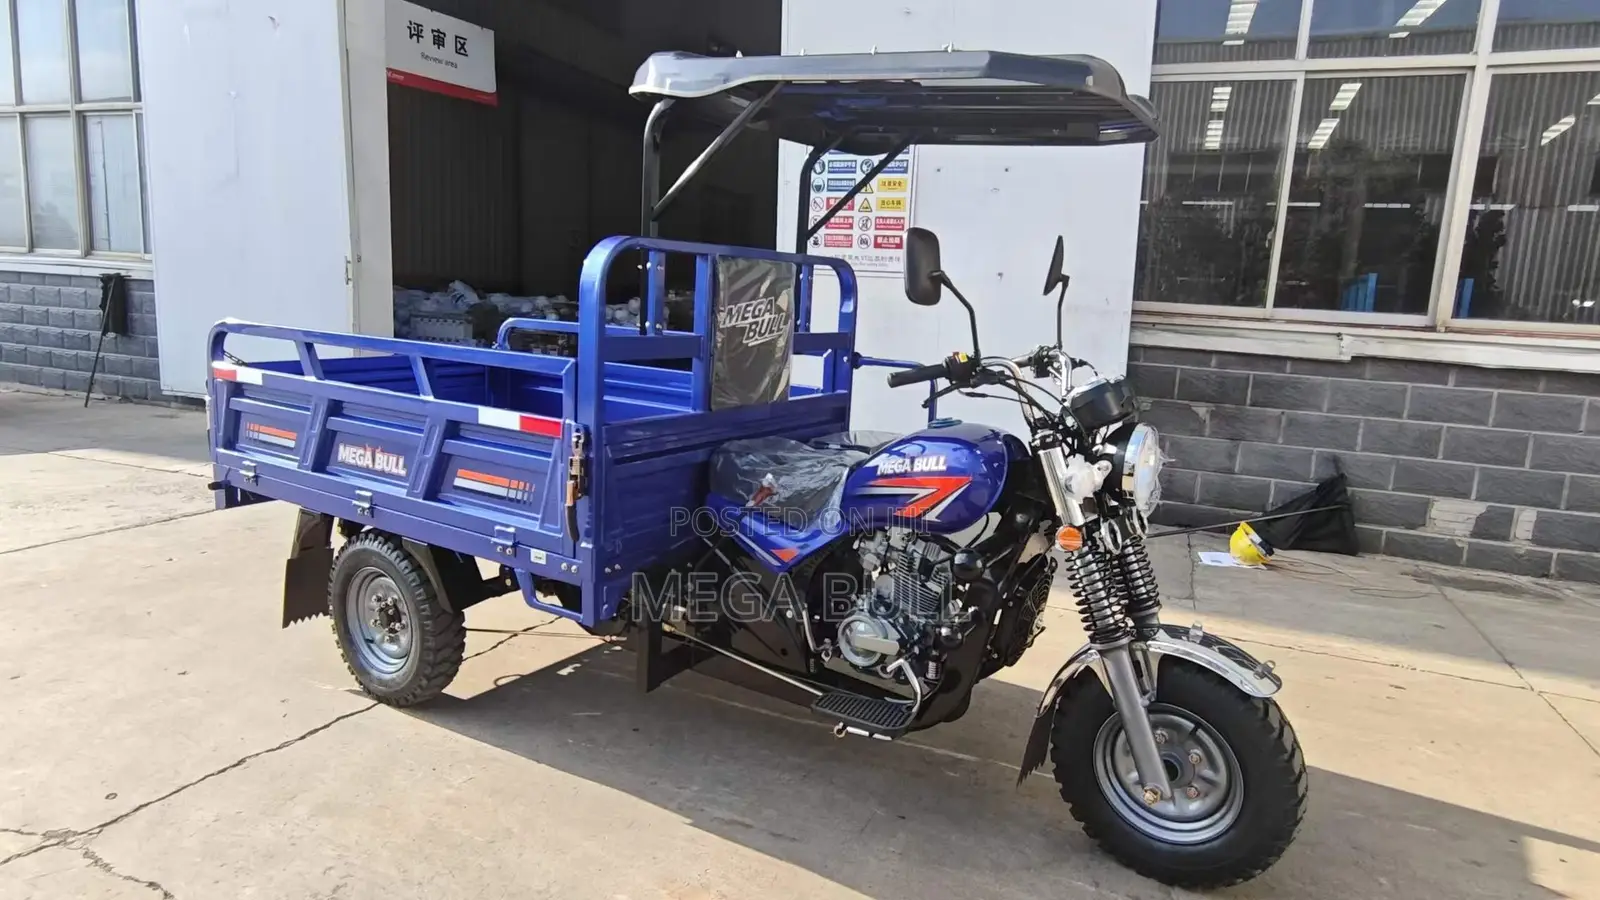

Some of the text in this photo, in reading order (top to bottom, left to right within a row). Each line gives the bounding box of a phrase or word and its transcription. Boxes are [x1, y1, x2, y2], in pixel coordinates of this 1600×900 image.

[407, 20, 468, 57] 评审区
[420, 51, 458, 69] Review area
[720, 296, 775, 328] MEGA
[743, 312, 786, 344] BULL
[338, 443, 407, 477] MEGA BULL
[876, 456, 947, 476] MEGA BULL
